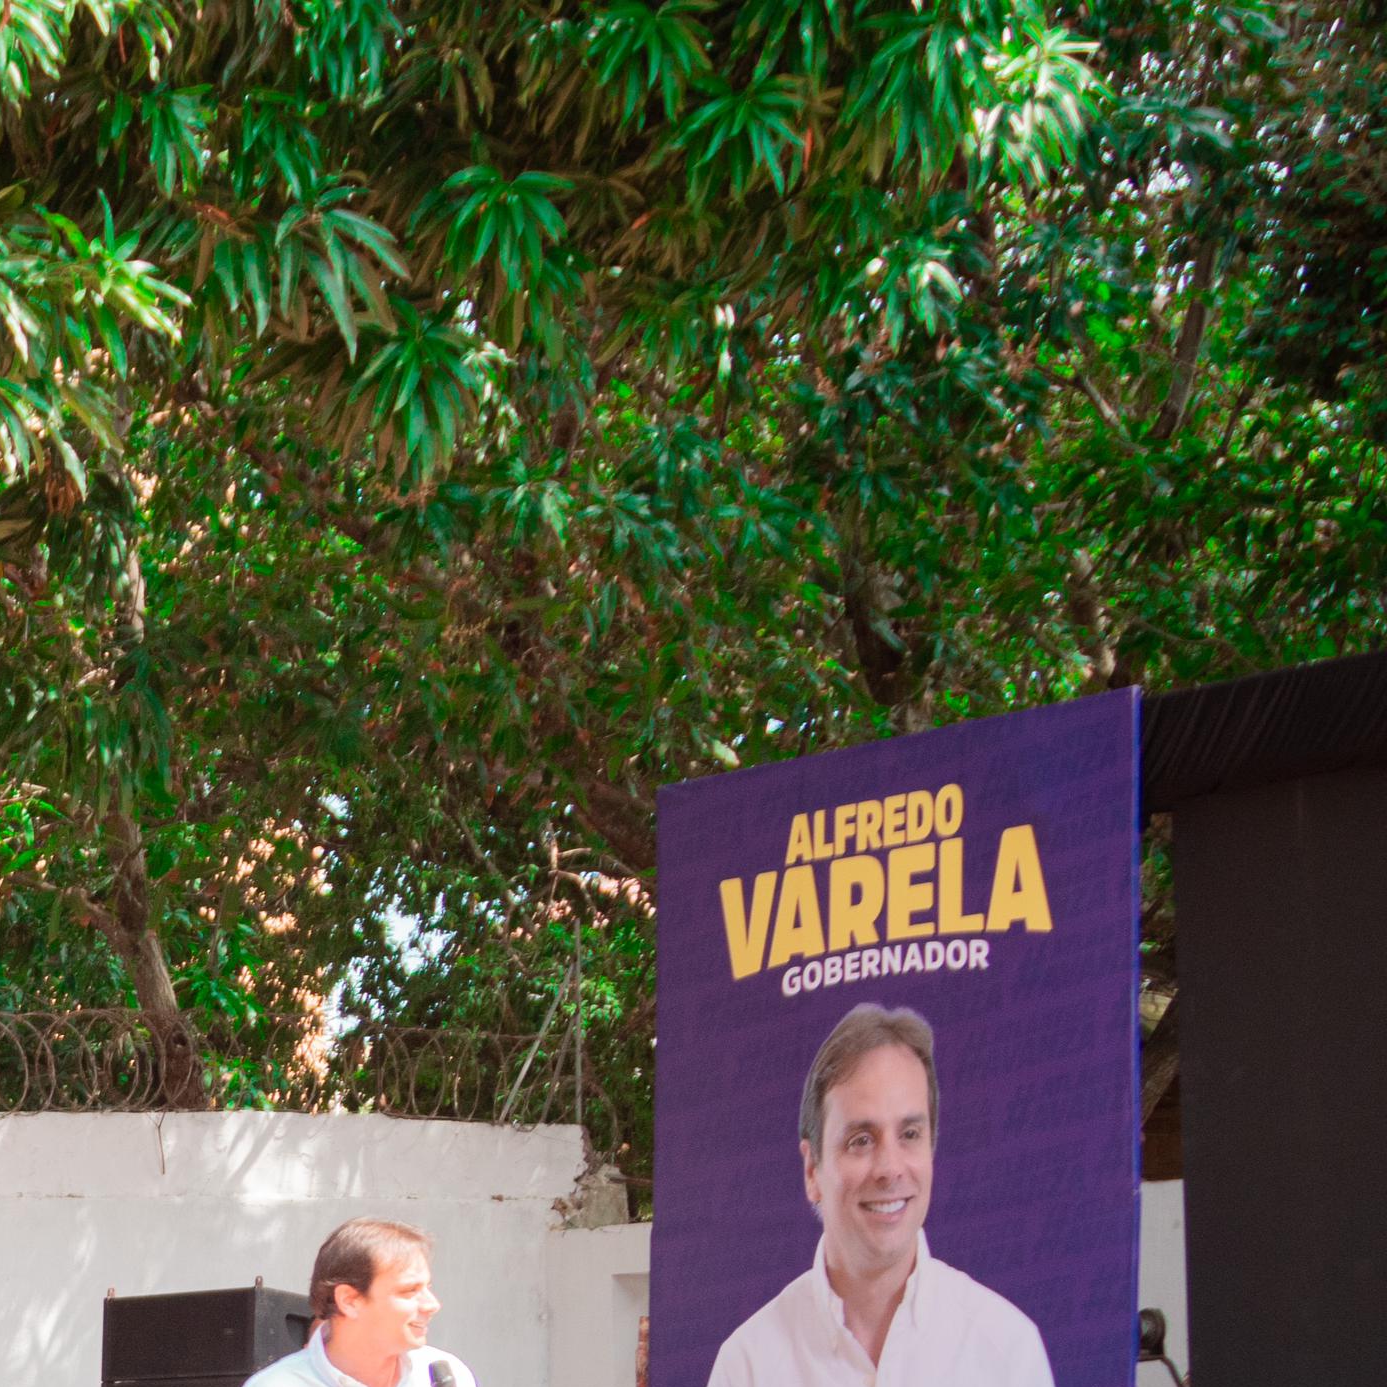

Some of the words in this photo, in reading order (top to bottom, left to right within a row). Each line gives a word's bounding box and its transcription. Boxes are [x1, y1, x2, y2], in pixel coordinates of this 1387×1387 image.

[784, 782, 964, 868] ALFREDO
[719, 823, 1054, 980] VARELA
[781, 937, 990, 998] GOBERNADOR
